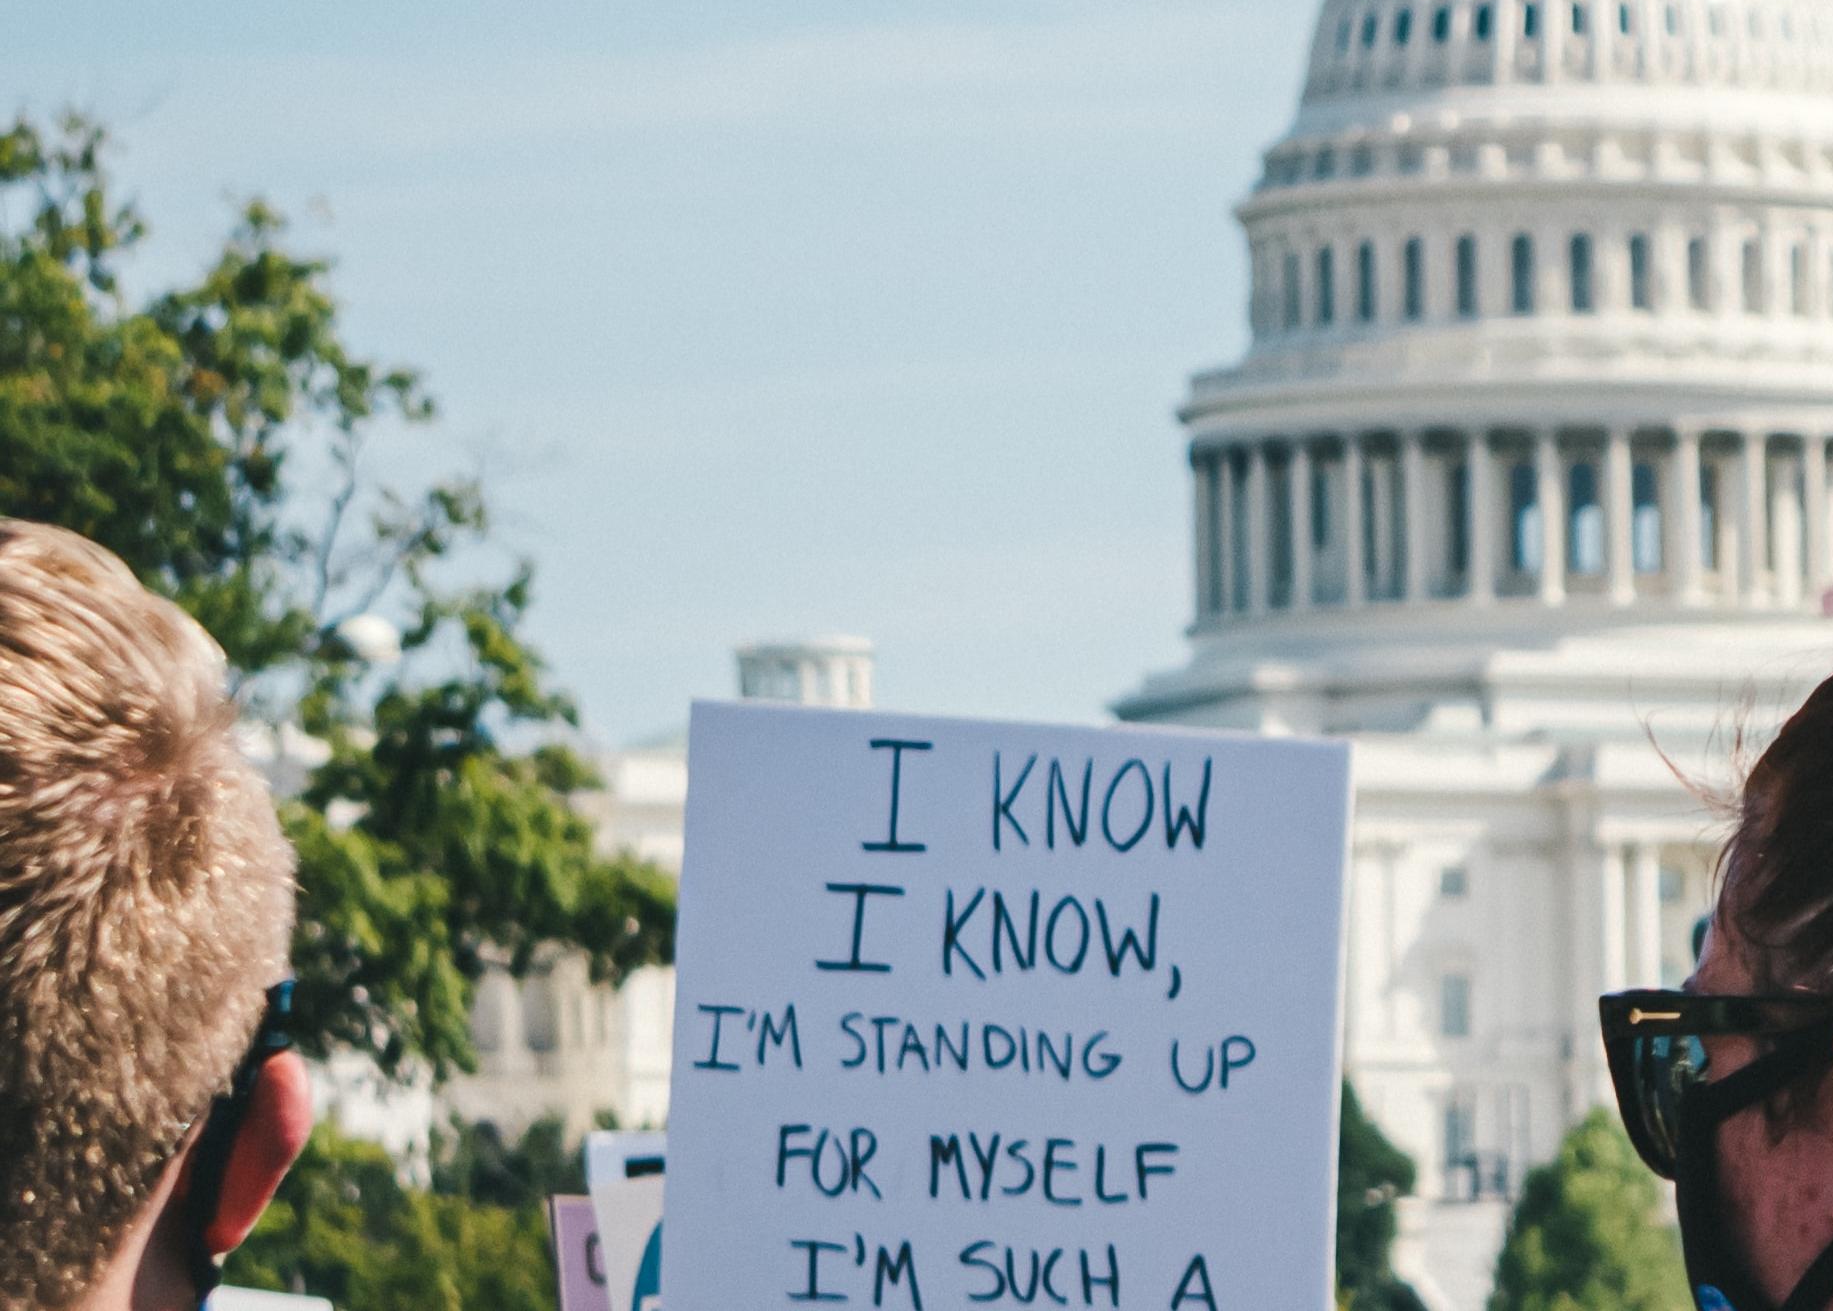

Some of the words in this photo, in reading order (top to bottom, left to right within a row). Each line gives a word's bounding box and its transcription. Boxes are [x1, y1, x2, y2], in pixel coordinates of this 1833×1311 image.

[861, 738, 932, 853] I
[992, 750, 1212, 853] KNOW
[815, 882, 905, 973] I
[943, 887, 1183, 1000] KNOW,
[694, 1003, 803, 1071] I'M
[840, 1013, 1122, 1082] STANDING
[1171, 1035, 1257, 1093] UP
[776, 1124, 882, 1199] FOR
[929, 1131, 1180, 1207] MYSELF
[788, 1234, 923, 1311] I'M
[959, 1240, 1119, 1309] SUCH
[1171, 1254, 1219, 1311] A
